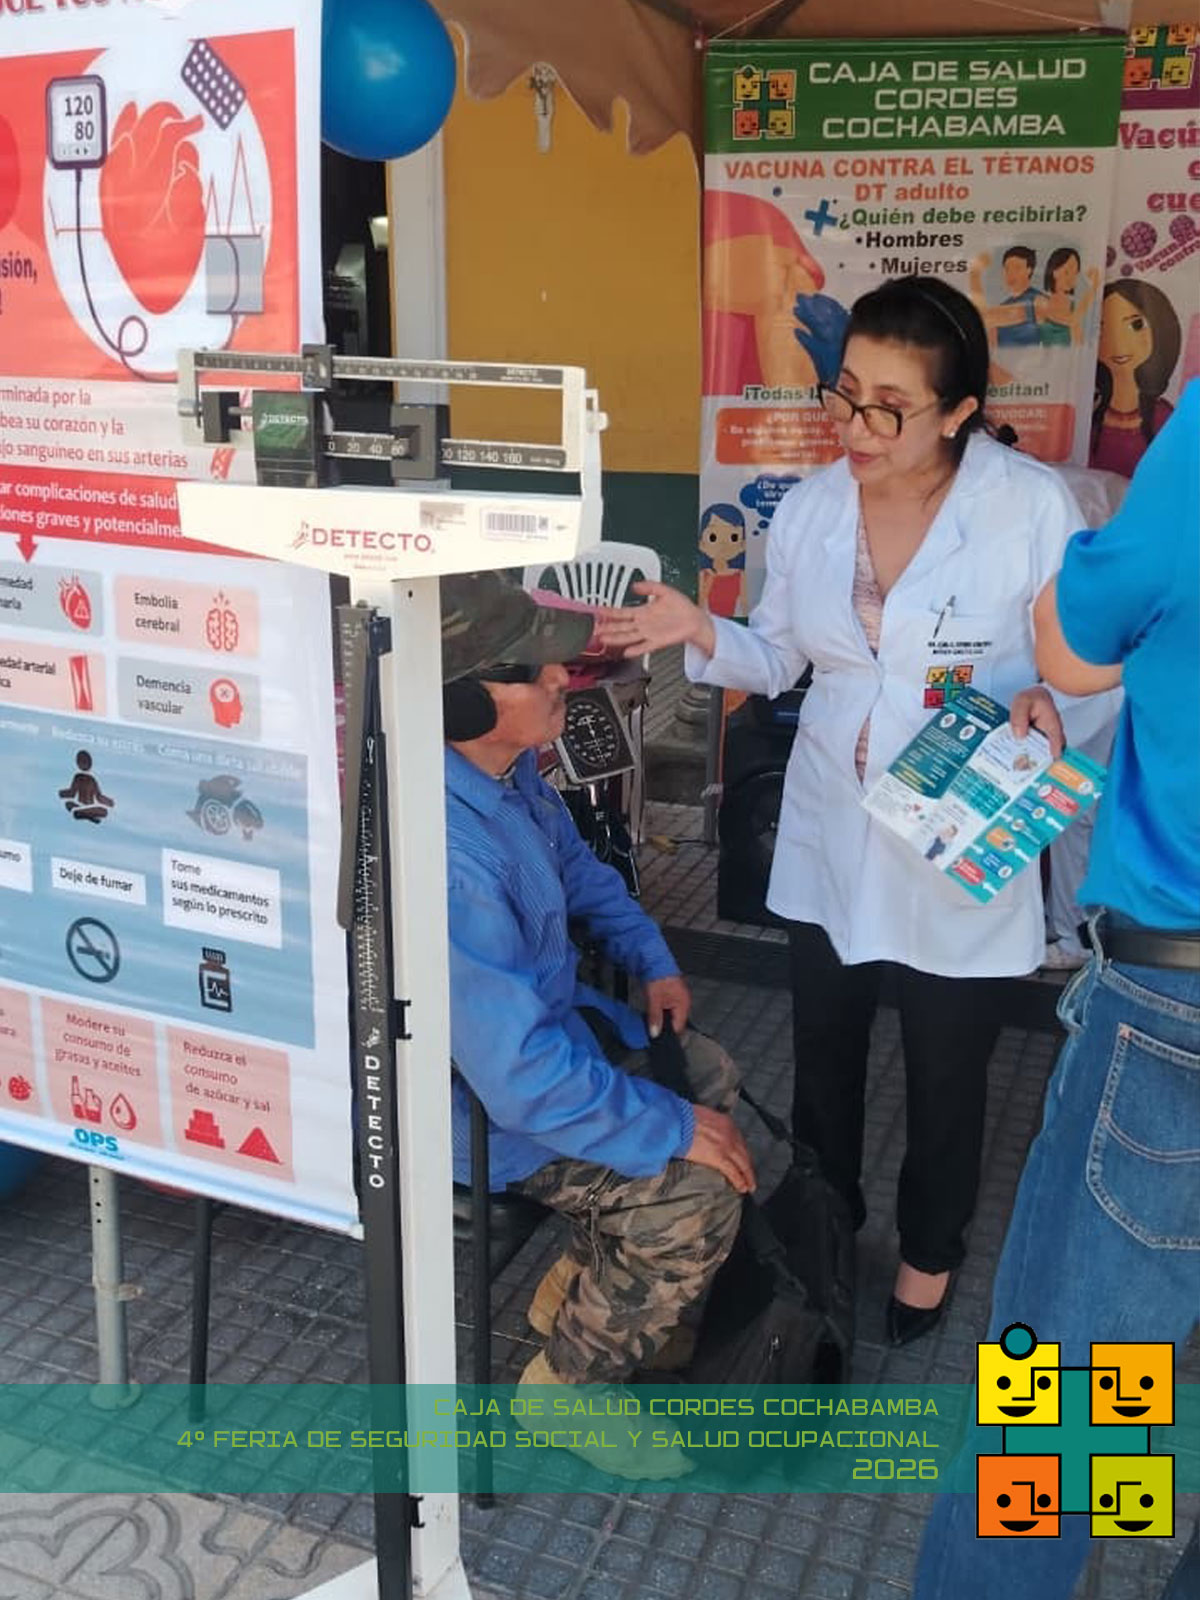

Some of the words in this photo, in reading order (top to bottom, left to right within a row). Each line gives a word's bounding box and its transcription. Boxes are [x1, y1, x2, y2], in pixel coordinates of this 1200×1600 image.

[809, 61, 901, 83] CAJA
[912, 61, 958, 81] DE
[969, 58, 1087, 80] SALUD
[64, 95, 93, 116] 120
[875, 87, 1018, 110] CORDES
[75, 121, 94, 140] 80
[823, 114, 1066, 138] COCHABAMBA
[724, 160, 825, 179] VACUNA
[834, 156, 935, 177] CONTRA
[944, 157, 973, 175] EL
[982, 152, 1095, 175] TÉTANOS
[855, 184, 886, 202] DT
[894, 182, 970, 201] adulto
[839, 207, 914, 230] ¿Quién
[922, 207, 976, 224] debe
[983, 205, 1087, 223] recibirla?
[866, 231, 964, 249] Hombres
[881, 257, 967, 275] Mujeres
[52, 391, 76, 408] por
[79, 388, 91, 405] la
[26, 417, 40, 429] su
[100, 421, 108, 437] y
[111, 417, 124, 435] la
[87, 449, 104, 462] en
[108, 450, 130, 464] sus
[133, 450, 187, 467] arterias
[346, 442, 360, 453] 20
[369, 443, 382, 454] 40
[457, 449, 476, 460] 120
[480, 450, 498, 462] 140
[503, 452, 522, 464] 160
[15, 482, 116, 505] complicaciones
[119, 488, 136, 506] de
[139, 491, 178, 510] salud
[36, 511, 80, 529] graves
[82, 516, 91, 533] y
[94, 517, 182, 538] potencialme
[311, 528, 432, 552] DETECTO
[134, 592, 178, 609] Embolia
[135, 619, 180, 632] cerebral
[136, 675, 192, 694] Demencia
[137, 699, 184, 714] vascular
[171, 859, 202, 875] Tome
[59, 867, 83, 884] Deje
[85, 872, 99, 884] de
[101, 875, 133, 891] fumar
[171, 880, 188, 892] sus
[190, 884, 269, 907] medicamentos
[206, 901, 217, 913] lo
[218, 906, 268, 924] prescrito
[66, 1012, 111, 1033] Modere
[112, 1024, 126, 1036] su
[63, 1032, 114, 1052] consumo
[116, 1043, 131, 1056] de
[183, 1041, 233, 1063] Reduzca
[235, 1055, 248, 1066] el
[92, 1058, 101, 1070] y
[183, 1064, 238, 1085] consumo
[185, 1082, 200, 1095] de
[203, 1088, 240, 1104] azúcar
[243, 1099, 251, 1110] y
[253, 1101, 271, 1112] sal
[364, 1054, 385, 1188] DETECTO
[74, 1128, 118, 1152] OPS
